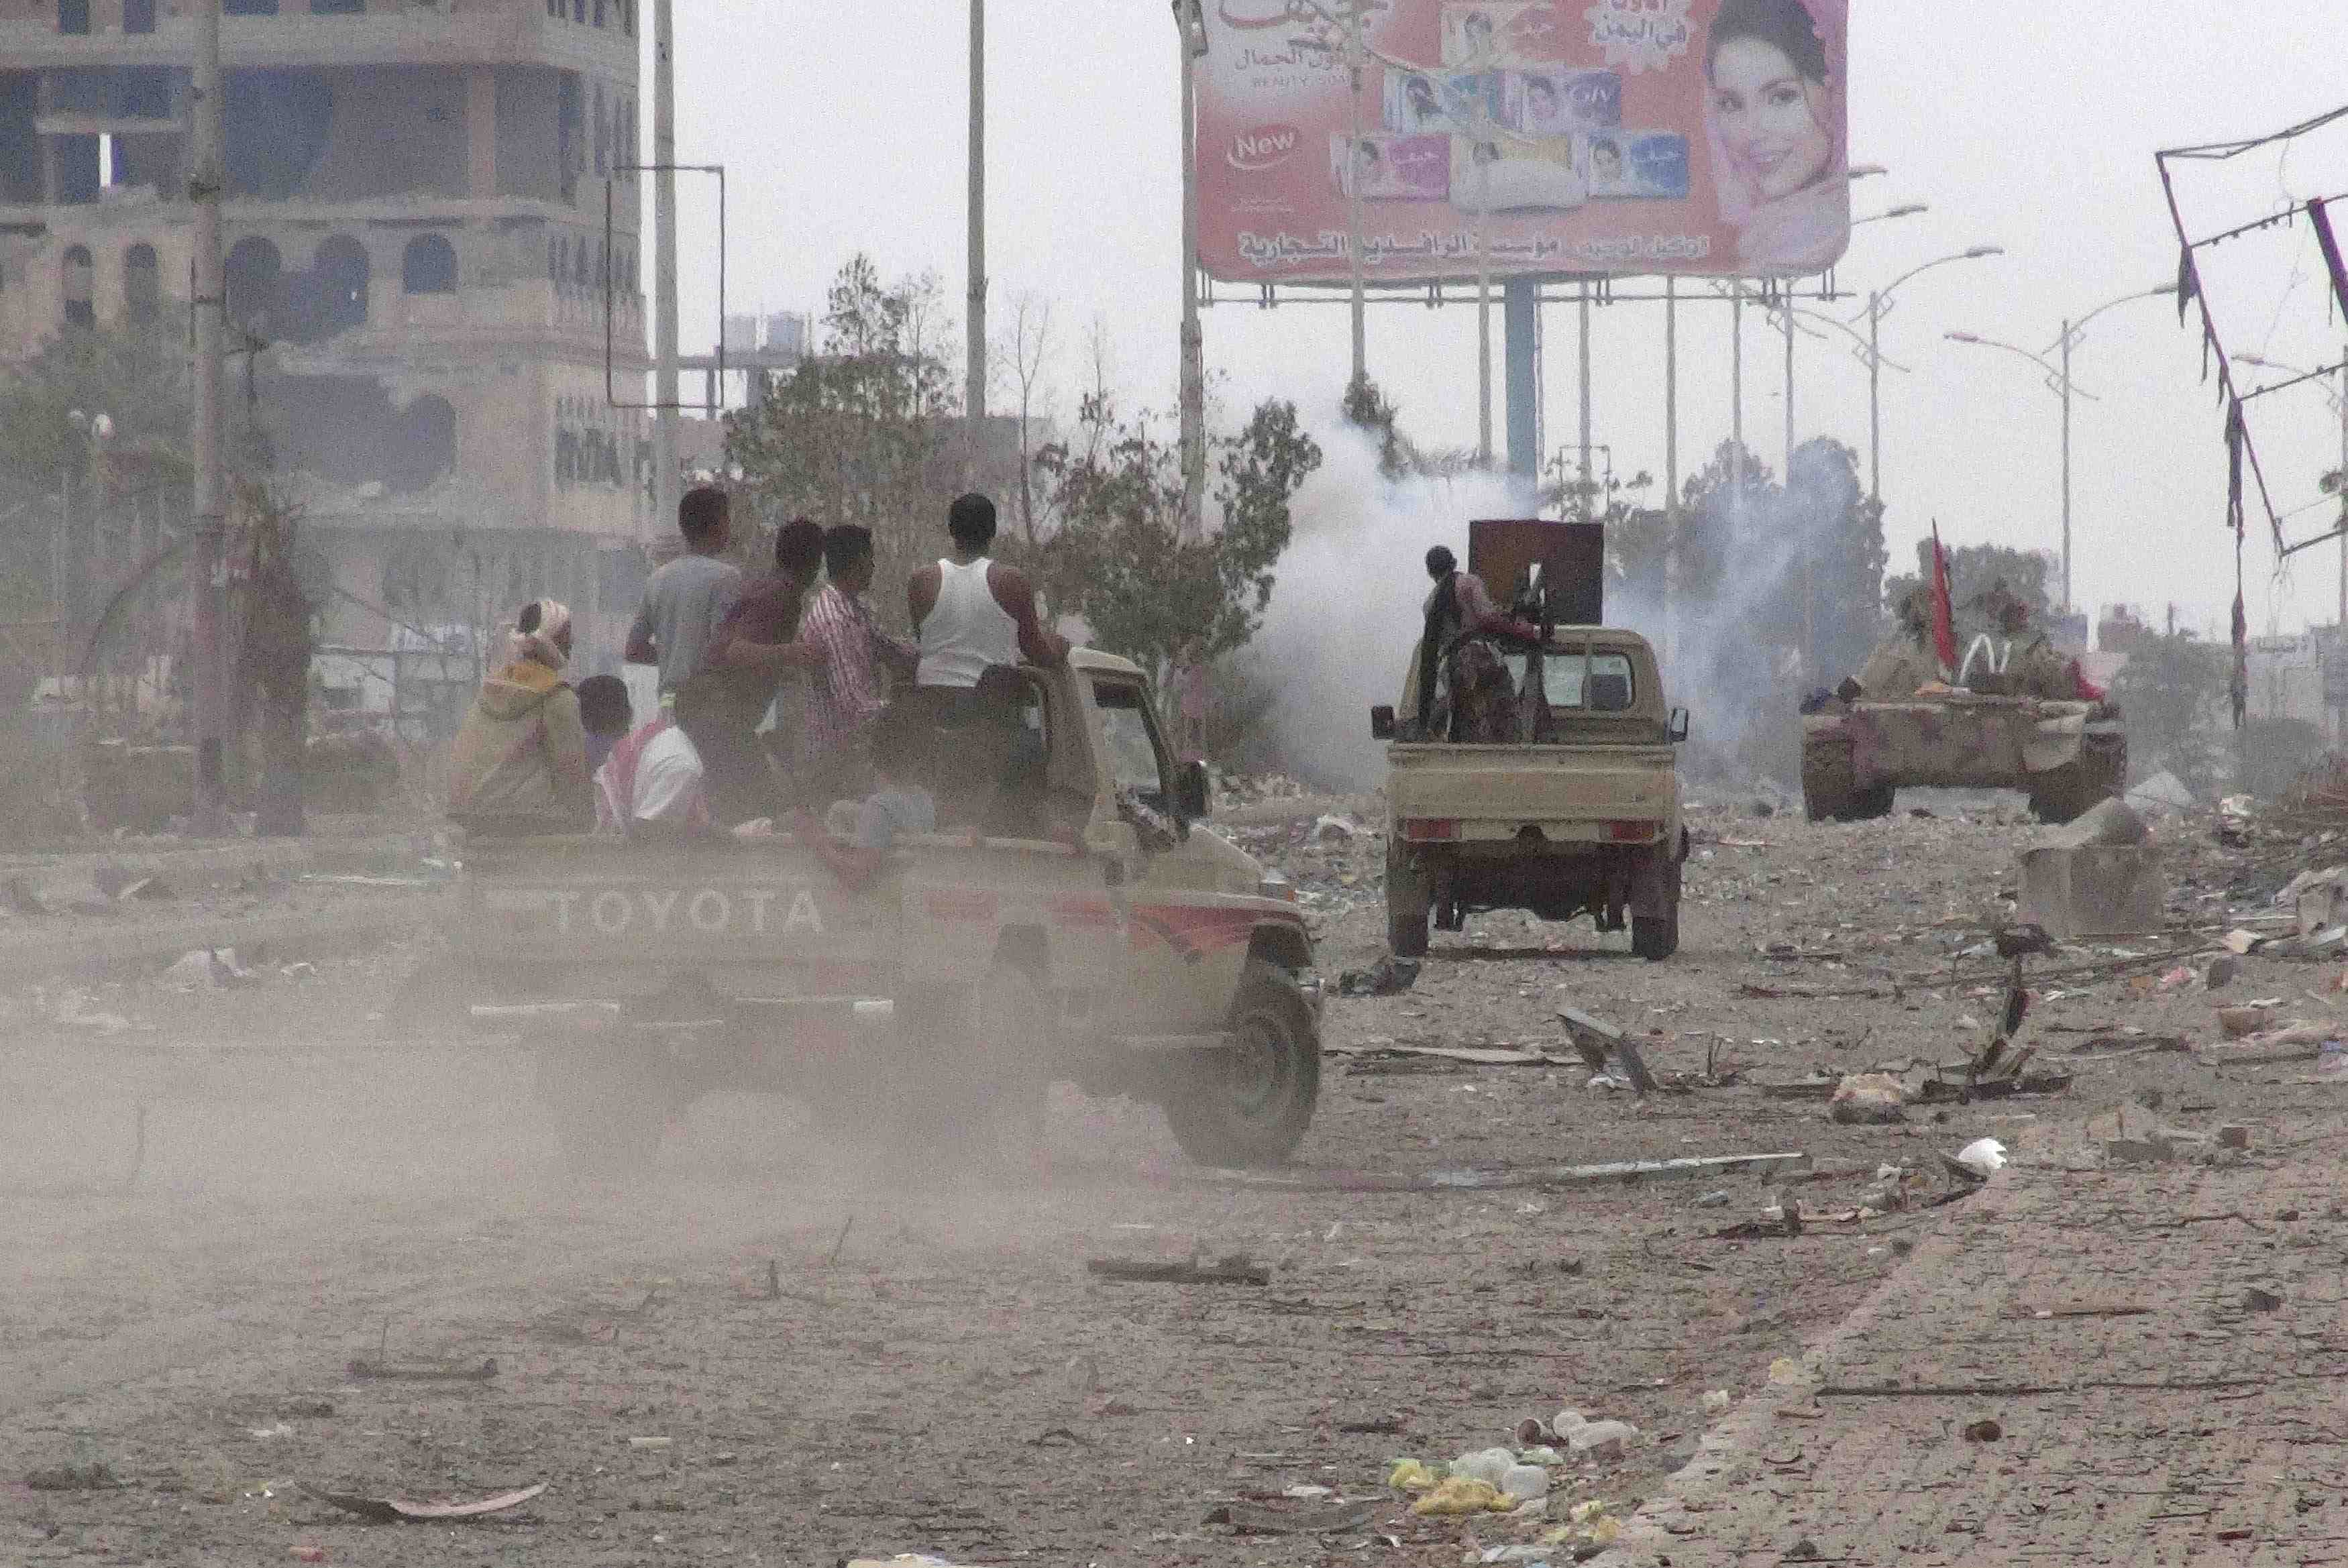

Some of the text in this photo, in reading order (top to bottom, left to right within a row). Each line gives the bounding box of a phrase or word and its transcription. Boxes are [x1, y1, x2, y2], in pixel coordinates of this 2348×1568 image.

[1595, 14, 1654, 46] اليمن
[1656, 19, 1687, 51] في
[1235, 131, 1295, 157] New
[545, 889, 825, 934] TOYOTA
